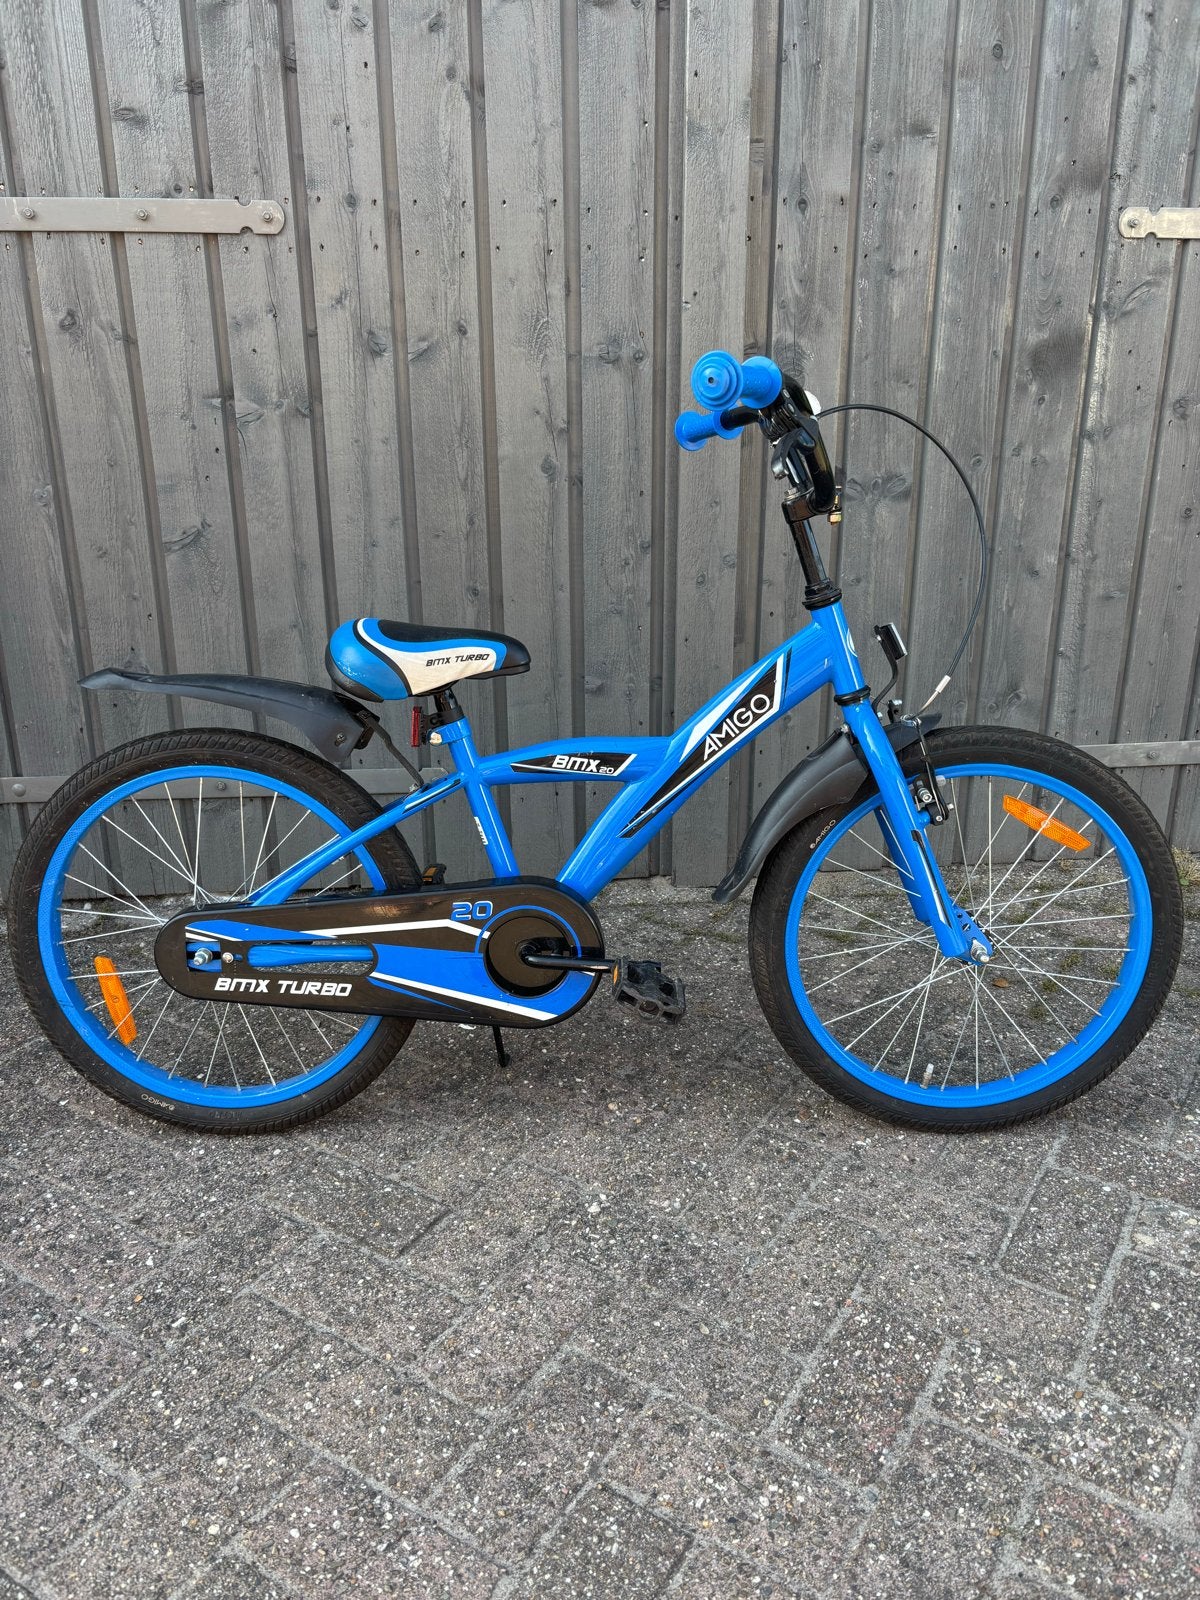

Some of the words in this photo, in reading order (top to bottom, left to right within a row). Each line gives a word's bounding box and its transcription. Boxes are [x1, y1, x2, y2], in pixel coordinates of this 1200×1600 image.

[426, 656, 451, 667] BMX
[454, 653, 490, 663] TURBO
[703, 693, 771, 762] AMIGO
[552, 754, 601, 773] BMX
[815, 819, 837, 845] AMIGO
[450, 900, 494, 921] 20
[214, 977, 271, 993] BMX
[277, 980, 353, 997] TURBO
[141, 1093, 169, 1110] AMIGO
